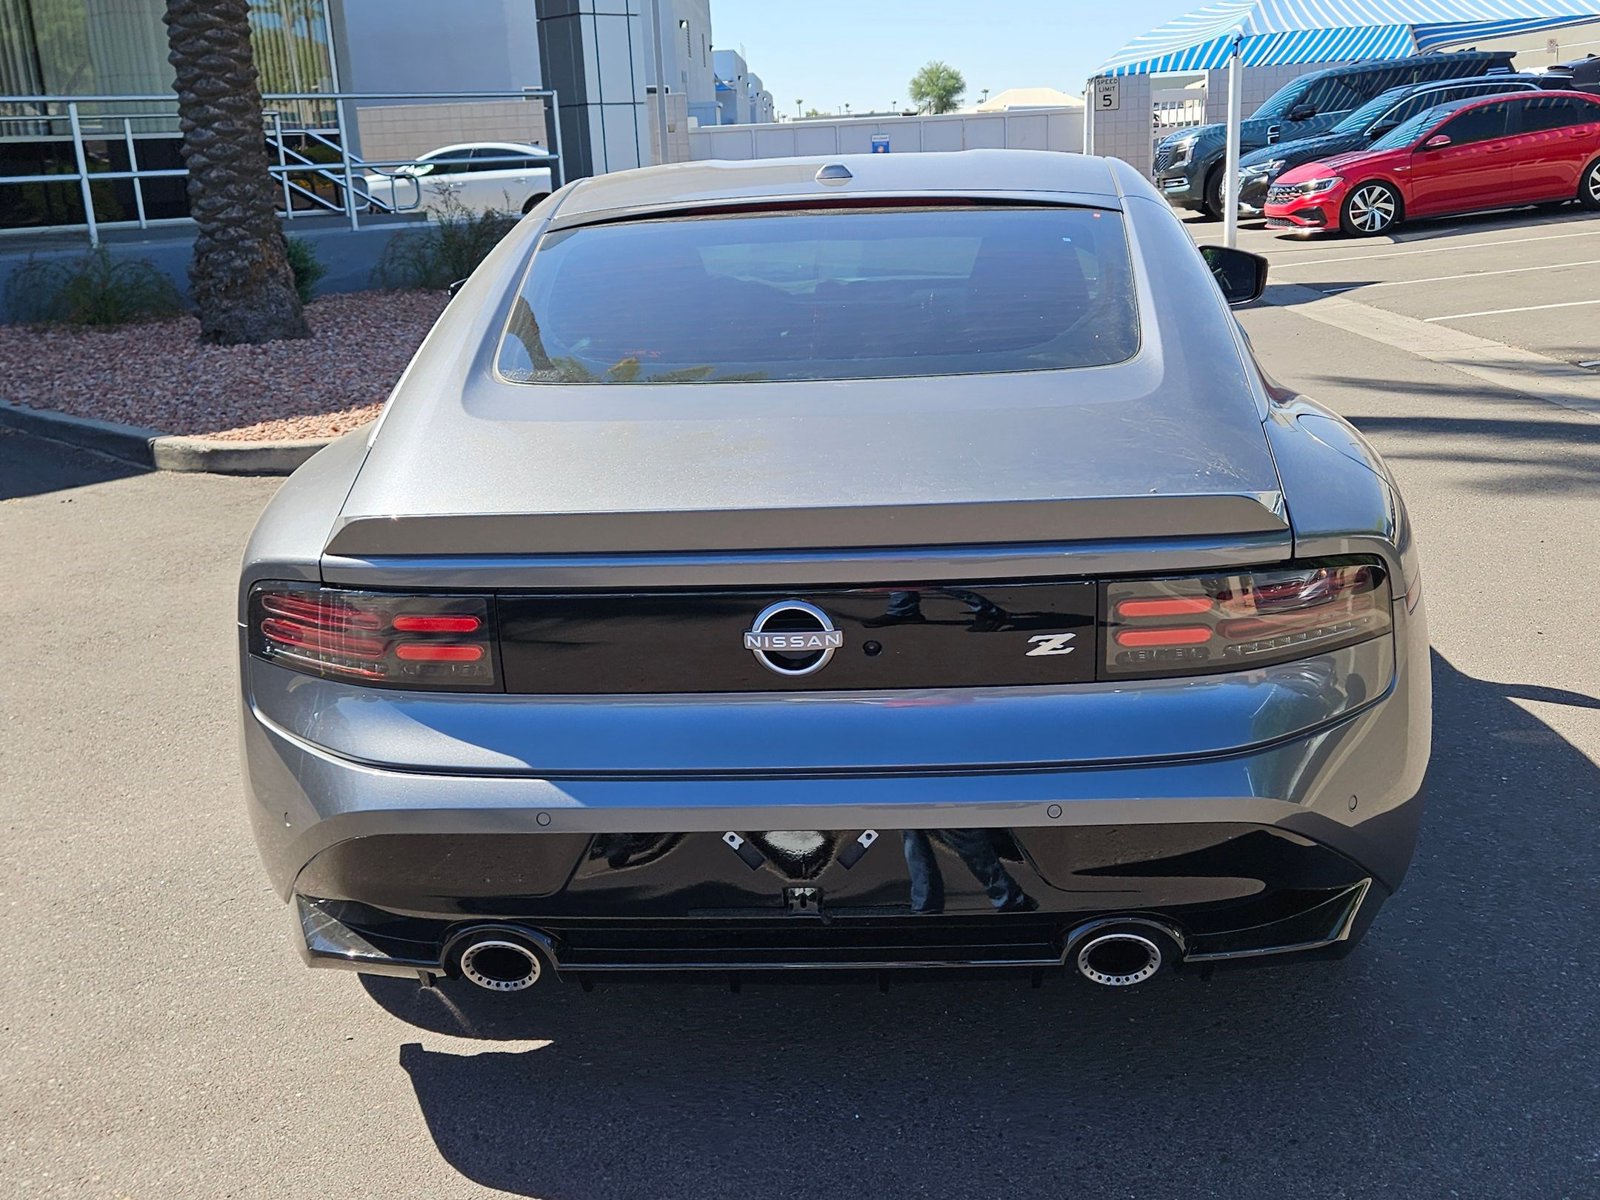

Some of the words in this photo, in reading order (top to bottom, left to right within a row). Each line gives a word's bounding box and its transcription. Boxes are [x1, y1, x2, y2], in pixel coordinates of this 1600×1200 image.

[1102, 94, 1112, 107] 5
[746, 633, 841, 649] NISSAN
[1025, 632, 1077, 657] Z
